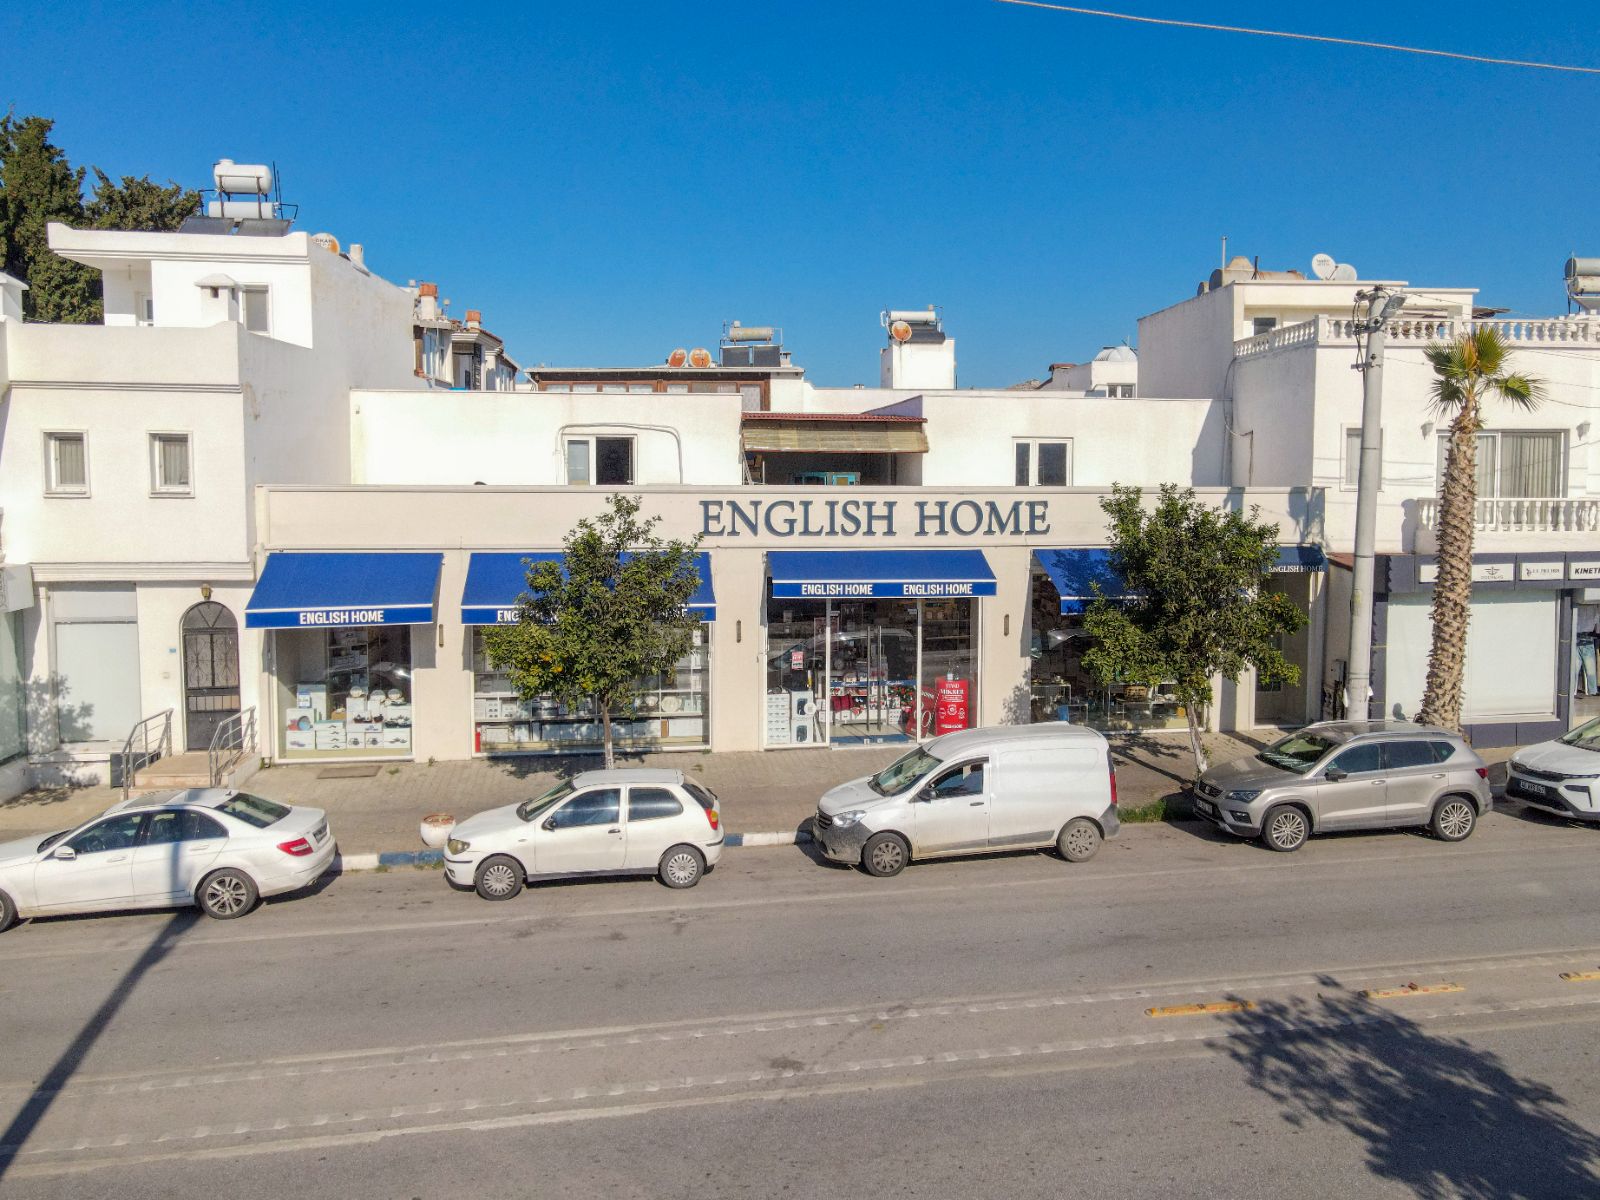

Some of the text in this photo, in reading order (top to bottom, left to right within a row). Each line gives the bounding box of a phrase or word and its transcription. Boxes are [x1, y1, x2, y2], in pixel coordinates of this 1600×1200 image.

[699, 500, 1051, 537] ENGLISH HOME
[801, 584, 873, 595] ENGLISH HOME
[903, 583, 973, 595] ENGLISH HOME
[299, 610, 385, 625] ENGLISH HOME
